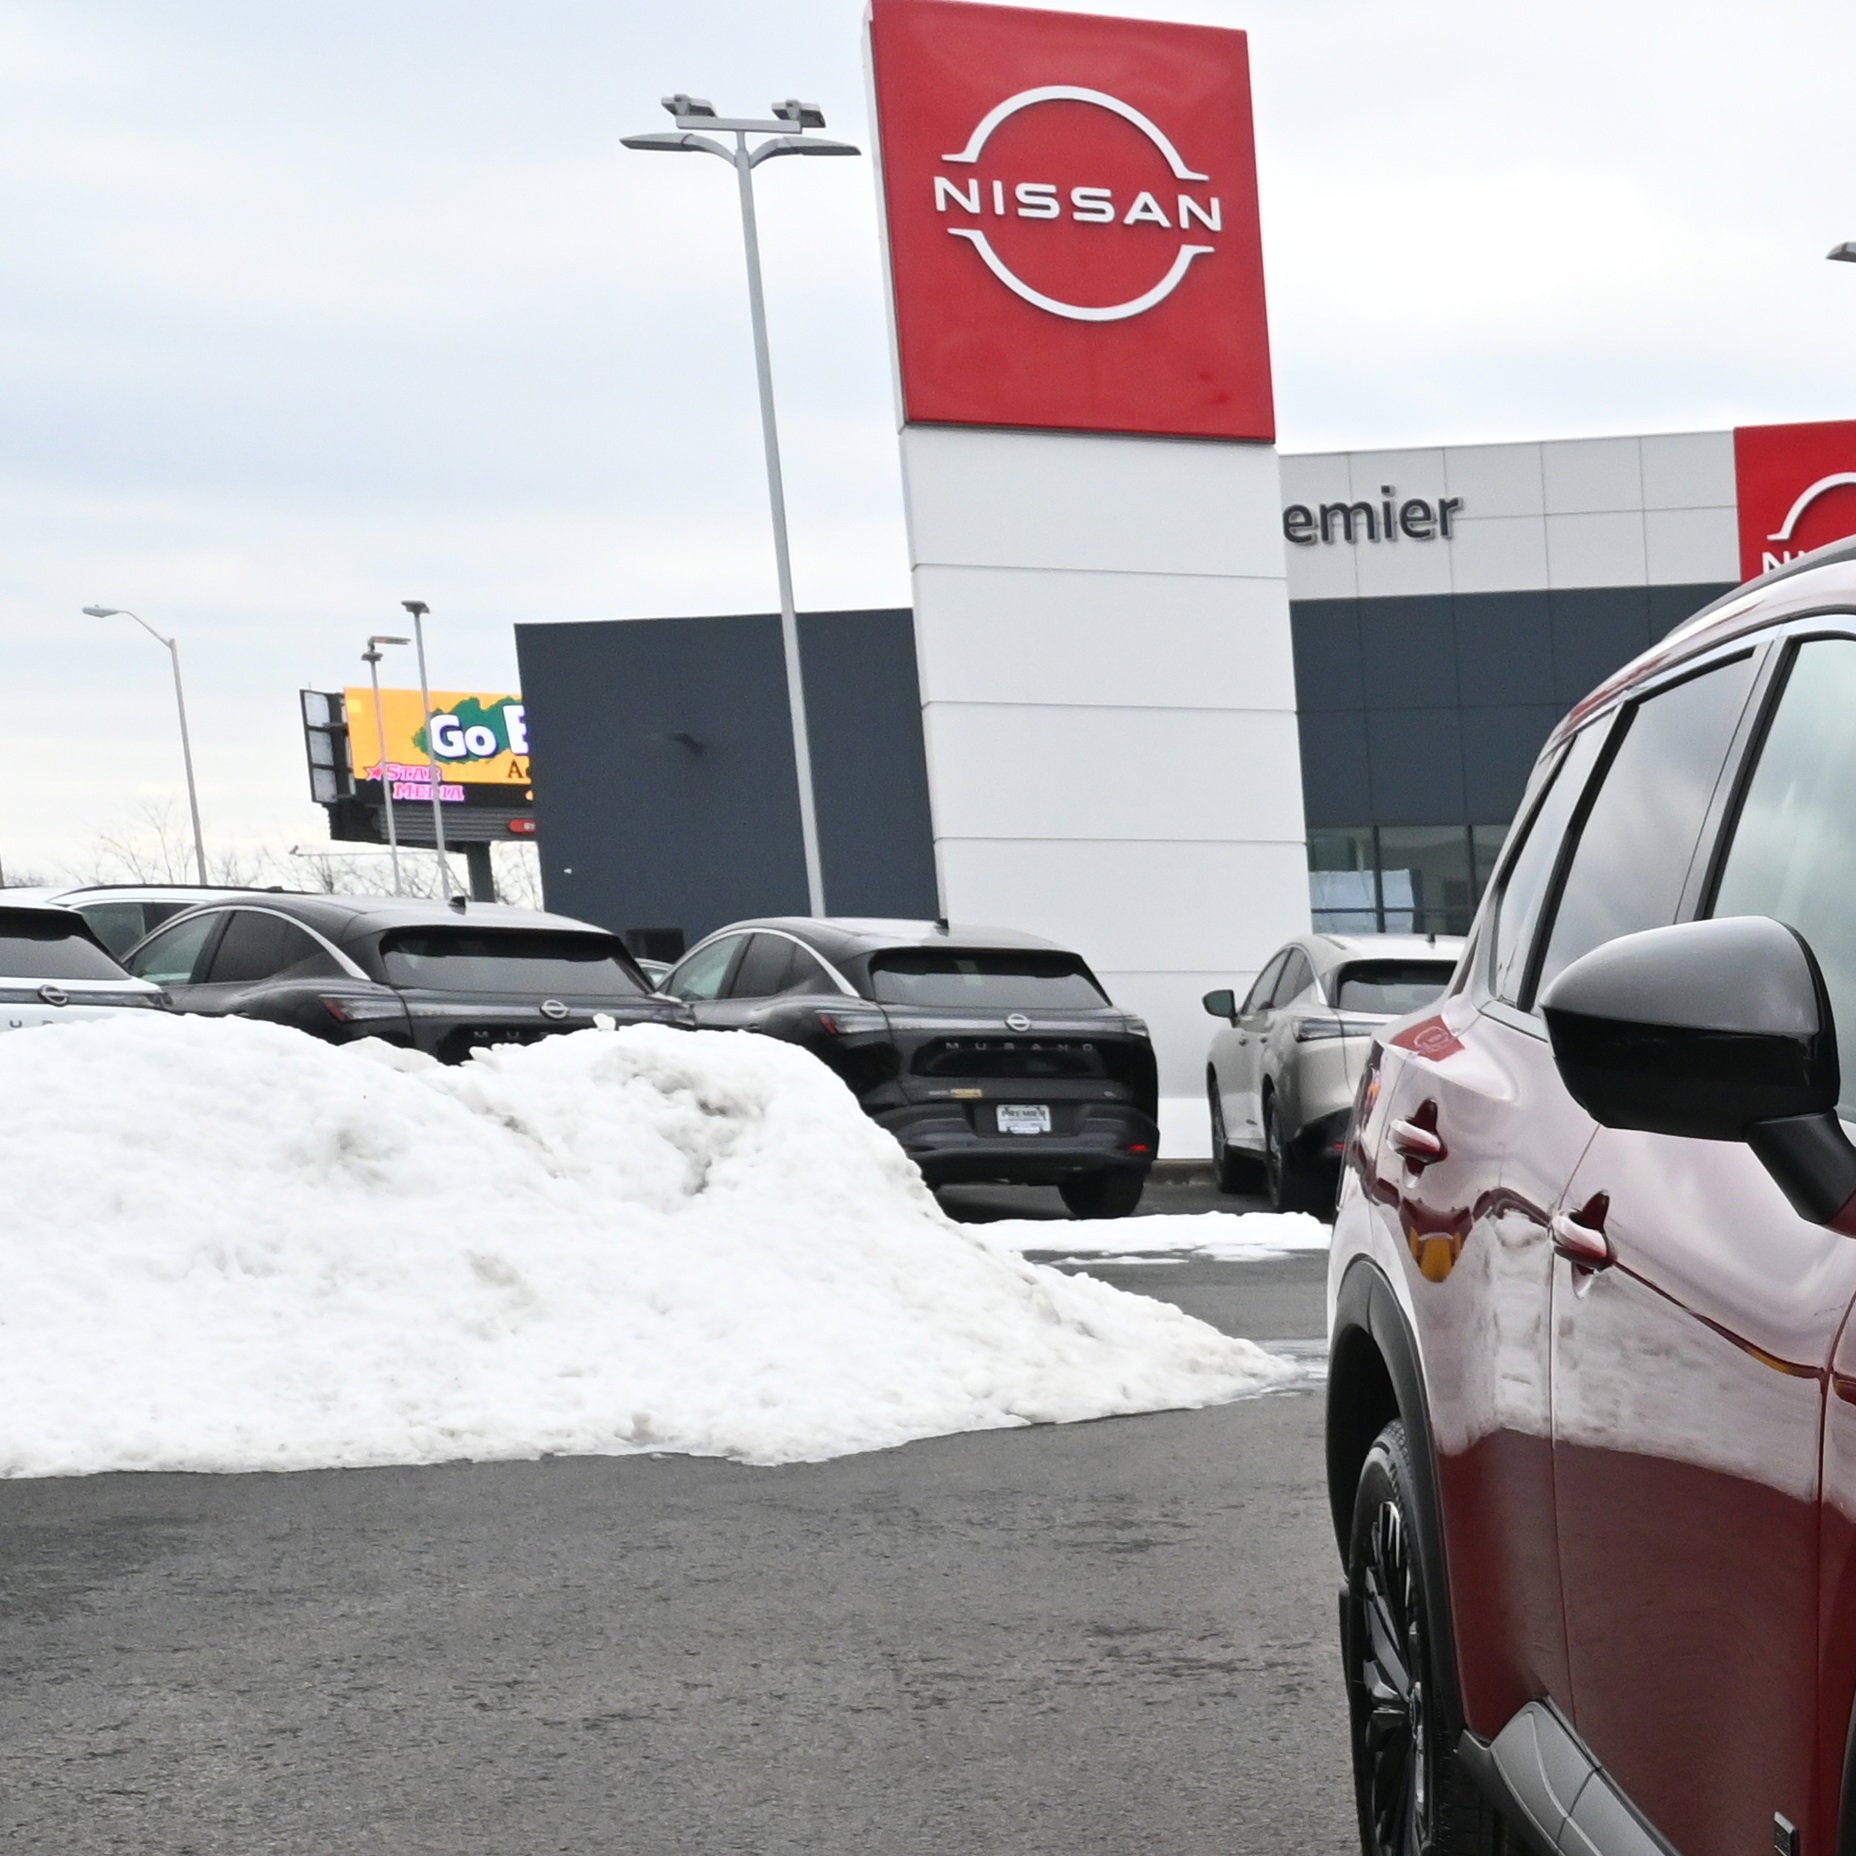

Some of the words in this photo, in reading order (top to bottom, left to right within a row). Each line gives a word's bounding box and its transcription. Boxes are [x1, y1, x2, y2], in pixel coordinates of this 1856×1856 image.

[933, 176, 1221, 231] NISSAN
[430, 714, 497, 757] Go
[945, 1041, 1094, 1051] MURANO
